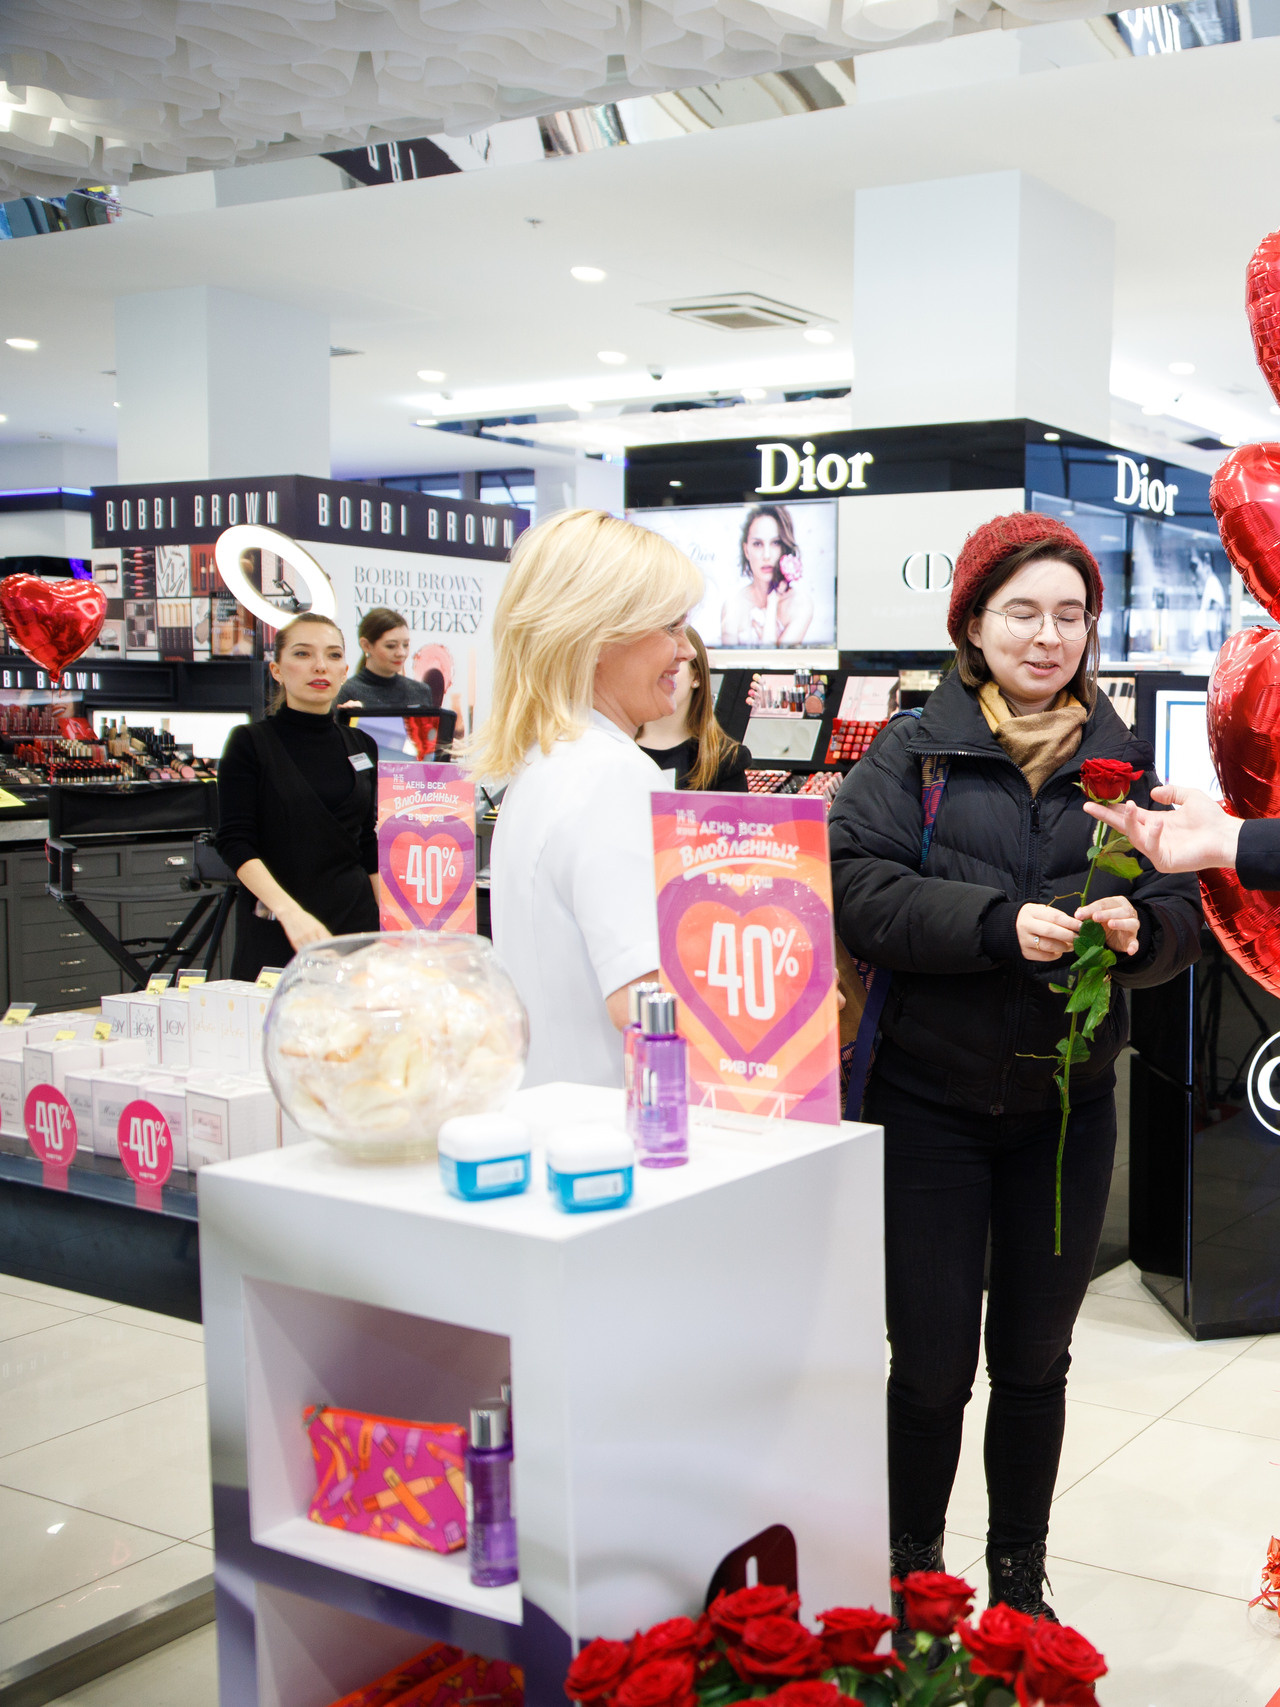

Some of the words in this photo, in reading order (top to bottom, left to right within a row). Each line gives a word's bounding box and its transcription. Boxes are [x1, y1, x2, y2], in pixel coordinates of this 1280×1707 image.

[755, 441, 874, 494] Dior
[1113, 454, 1179, 517] Dior
[106, 497, 176, 532] BOBBI
[194, 491, 279, 528] BROWN
[318, 493, 407, 536] BOBBI
[427, 508, 515, 549] BROWN
[354, 565, 411, 587] BOBBI
[417, 571, 483, 592] BROWN
[354, 586, 389, 605] МЫ
[394, 588, 482, 612] ОБУЧАЕМ
[393, 790, 460, 811] Влюбленных
[405, 780, 426, 790] ДЕНЬ
[427, 781, 447, 790] ВСЕХ
[699, 820, 735, 836] ДЕНЬ
[738, 821, 775, 837] ВСЕХ
[679, 835, 800, 868] Влюбленных
[398, 845, 457, 906] -40%
[694, 921, 800, 1021] -40%
[163, 1019, 187, 1036] JOY
[29, 1100, 72, 1151] -40%
[122, 1117, 167, 1169] -40%
